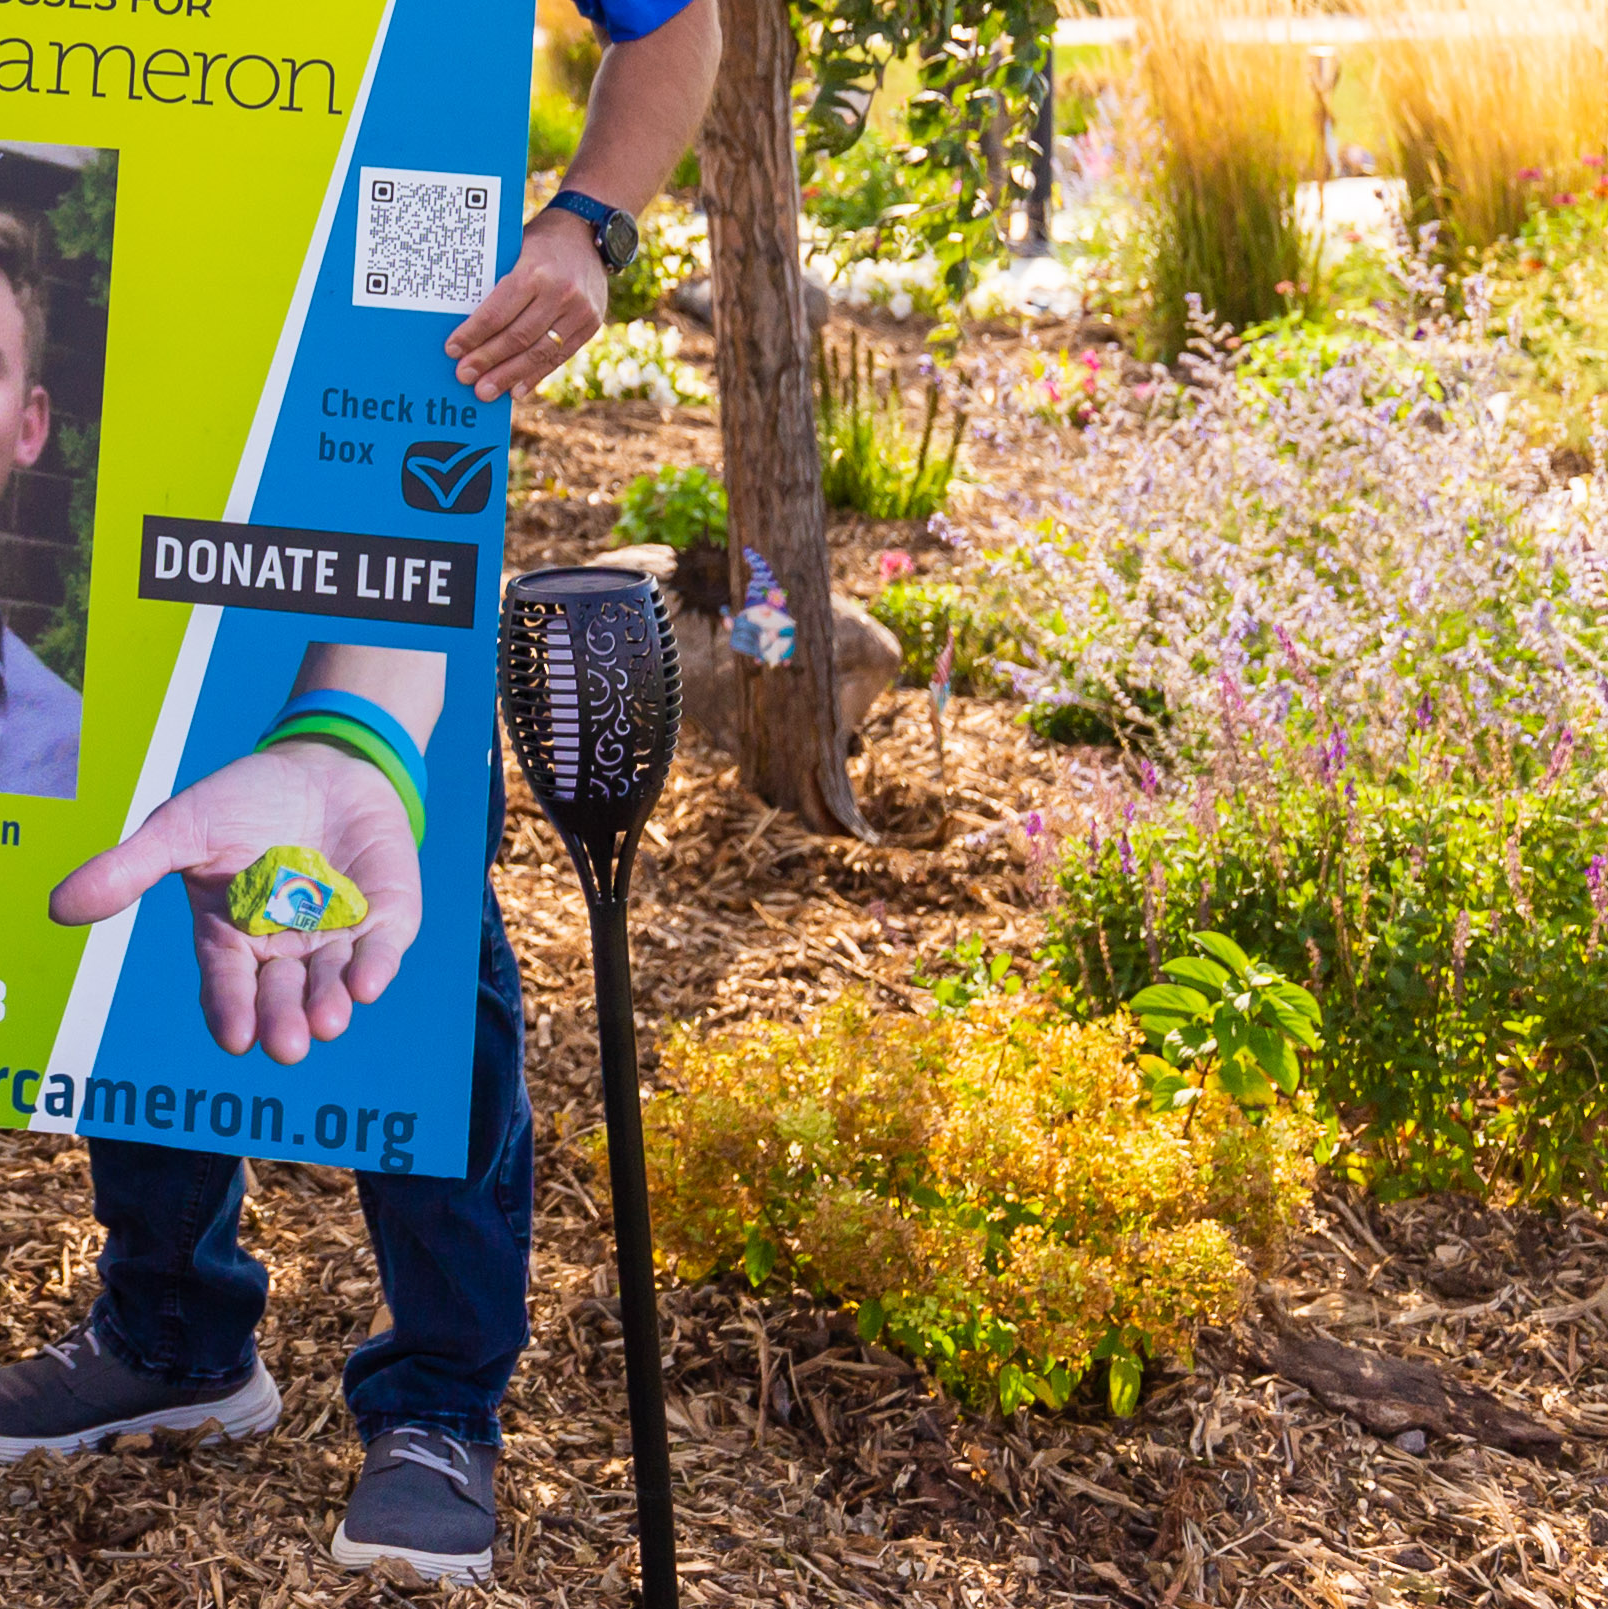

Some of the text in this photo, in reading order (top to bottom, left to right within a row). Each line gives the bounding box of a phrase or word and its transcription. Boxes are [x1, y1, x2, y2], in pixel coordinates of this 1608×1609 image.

[321, 387, 478, 429] Check the
[318, 431, 375, 466] box
[155, 534, 453, 606] DONATE LIFE
[295, 914, 317, 930] LIFE
